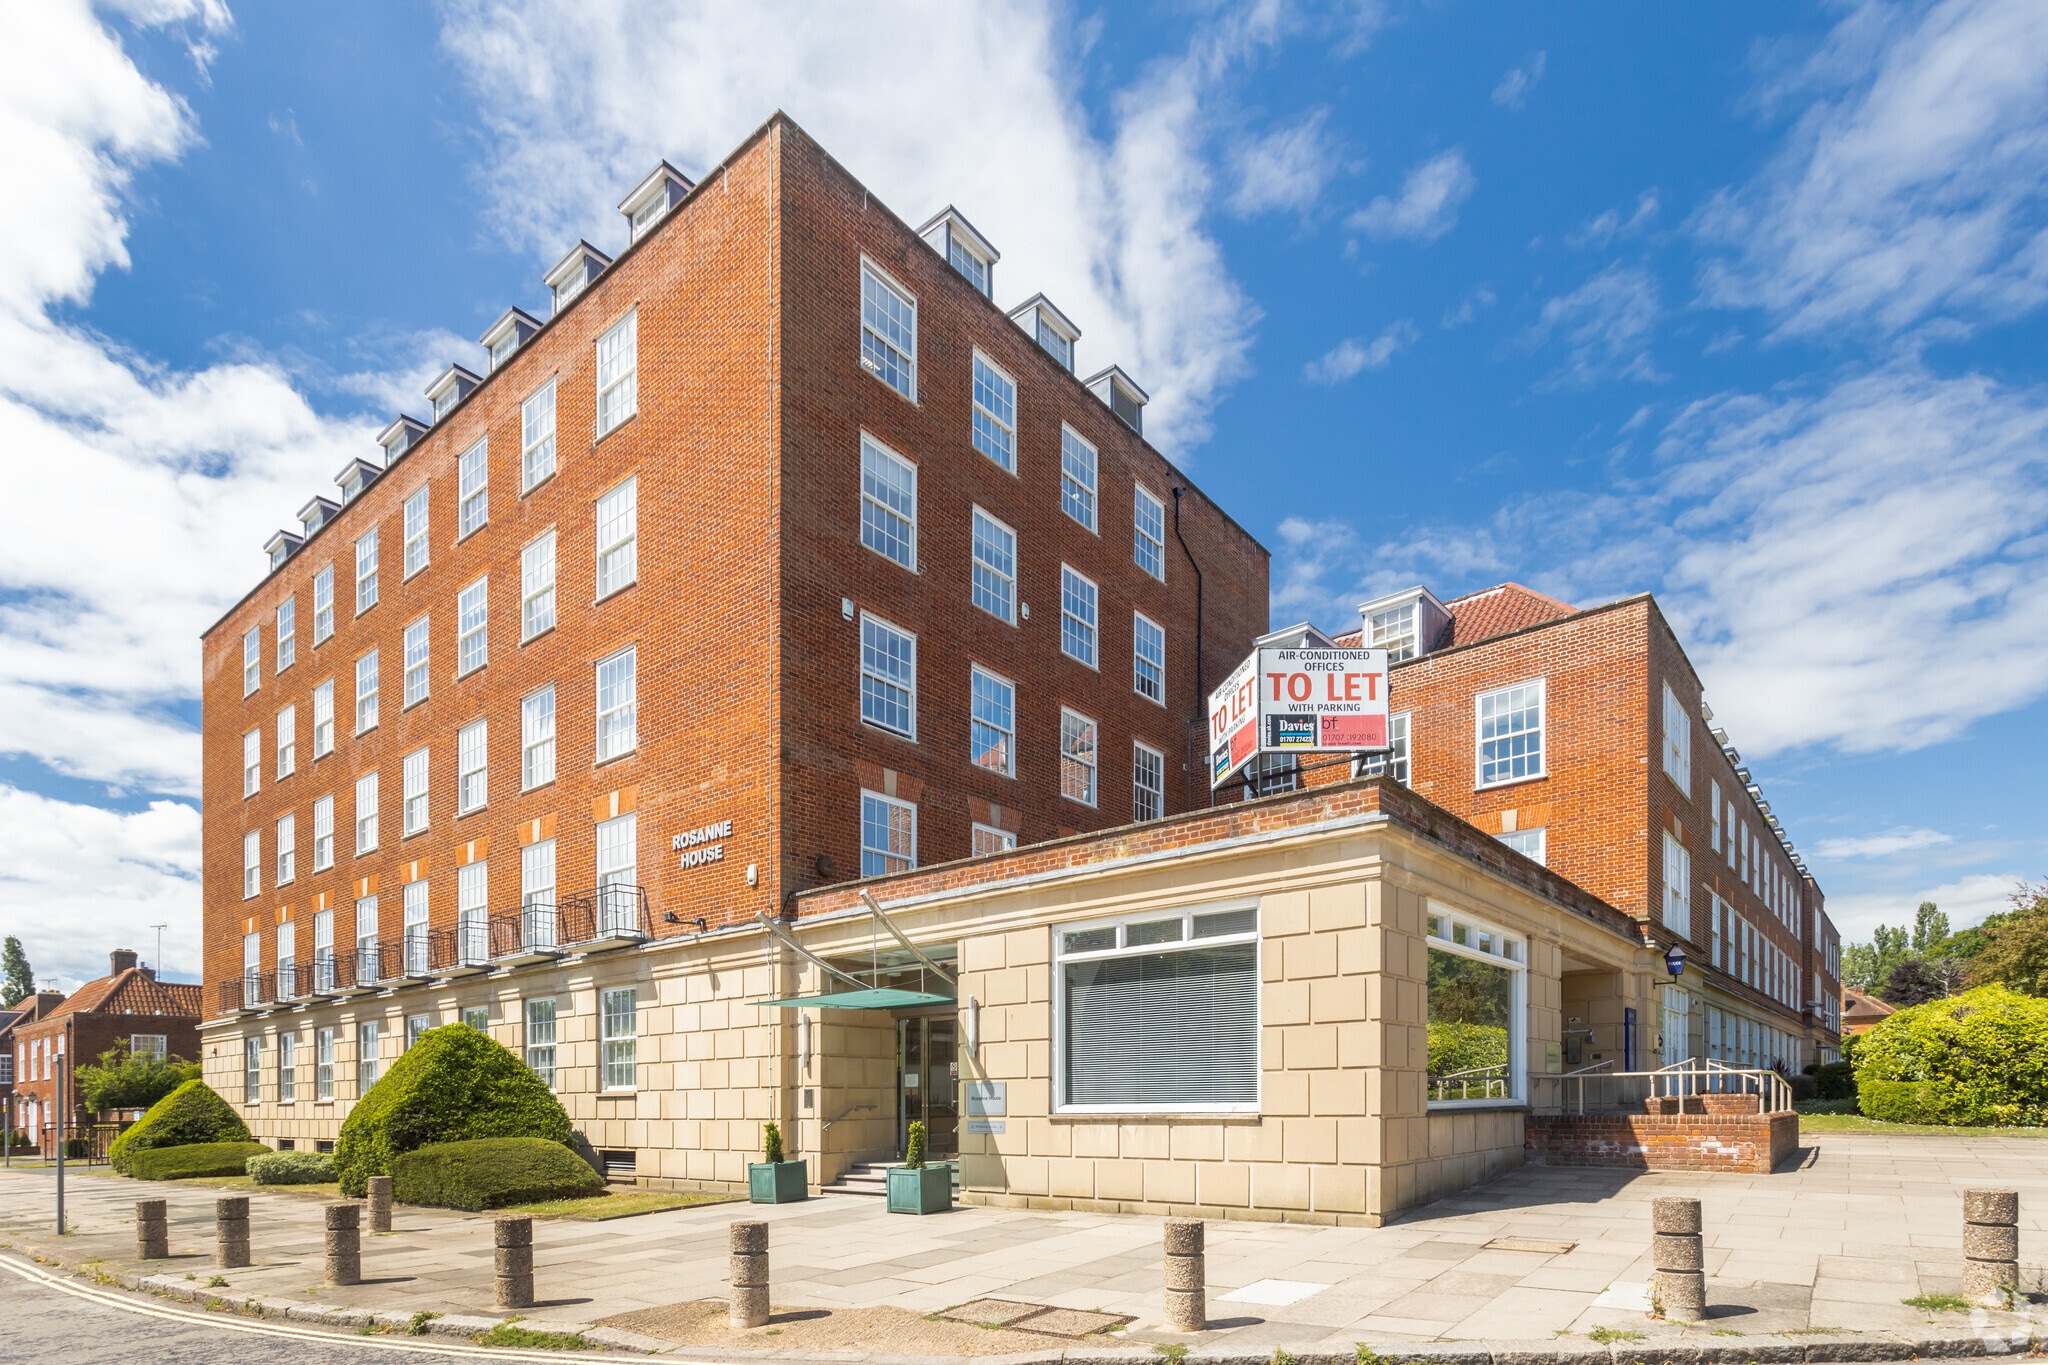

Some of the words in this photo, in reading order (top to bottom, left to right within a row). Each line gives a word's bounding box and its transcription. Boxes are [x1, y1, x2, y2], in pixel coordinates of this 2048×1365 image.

[1278, 650, 1371, 661] AIR-CONDITIONED
[1304, 662, 1345, 672] OFFICES
[1266, 672, 1313, 702] TO
[1327, 672, 1383, 702] LET
[1211, 704, 1228, 741] TO
[1232, 675, 1256, 722] LET
[1288, 703, 1314, 712] WITH
[1317, 703, 1361, 712] PARKING
[1279, 717, 1315, 732] Davies
[1322, 733, 1345, 741] 01707
[1348, 732, 1377, 741] 392080
[672, 820, 732, 850] ROSANNE
[680, 844, 723, 869] HOUSE
